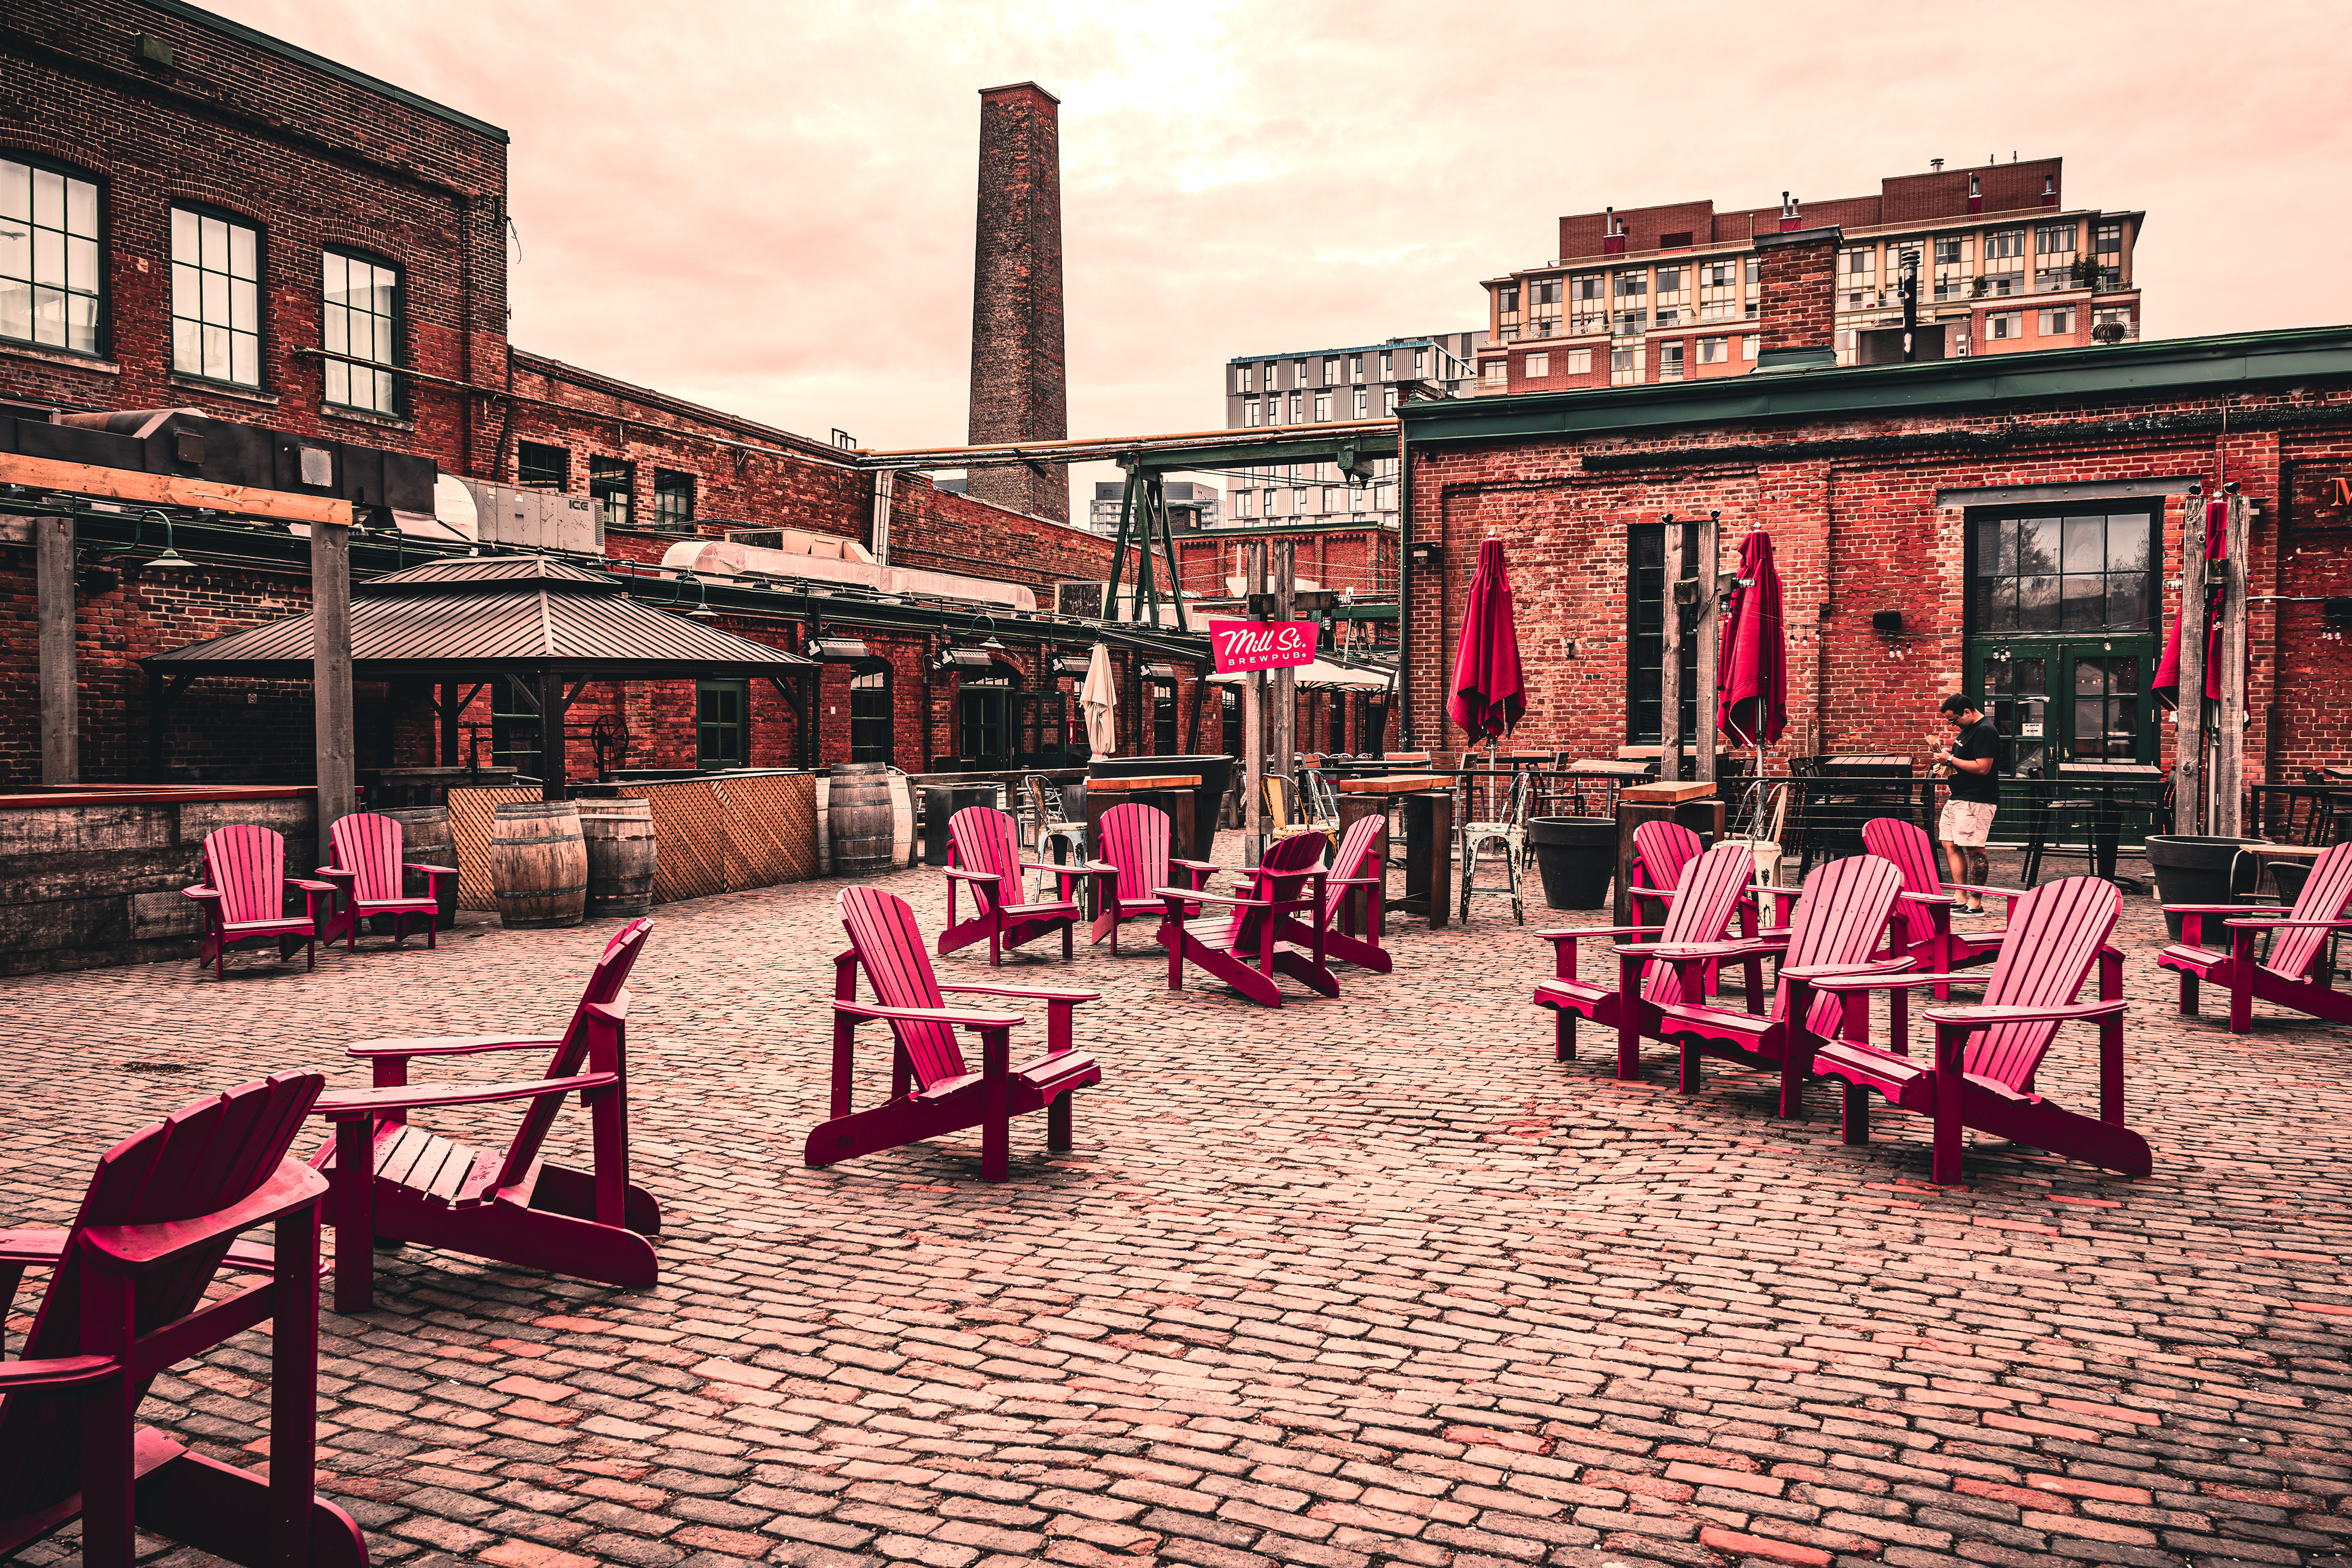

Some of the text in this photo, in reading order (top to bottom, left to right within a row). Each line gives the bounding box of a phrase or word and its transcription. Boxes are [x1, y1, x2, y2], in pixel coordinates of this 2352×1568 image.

[569, 499, 589, 511] ICE
[1218, 627, 1306, 656] Mill St.
